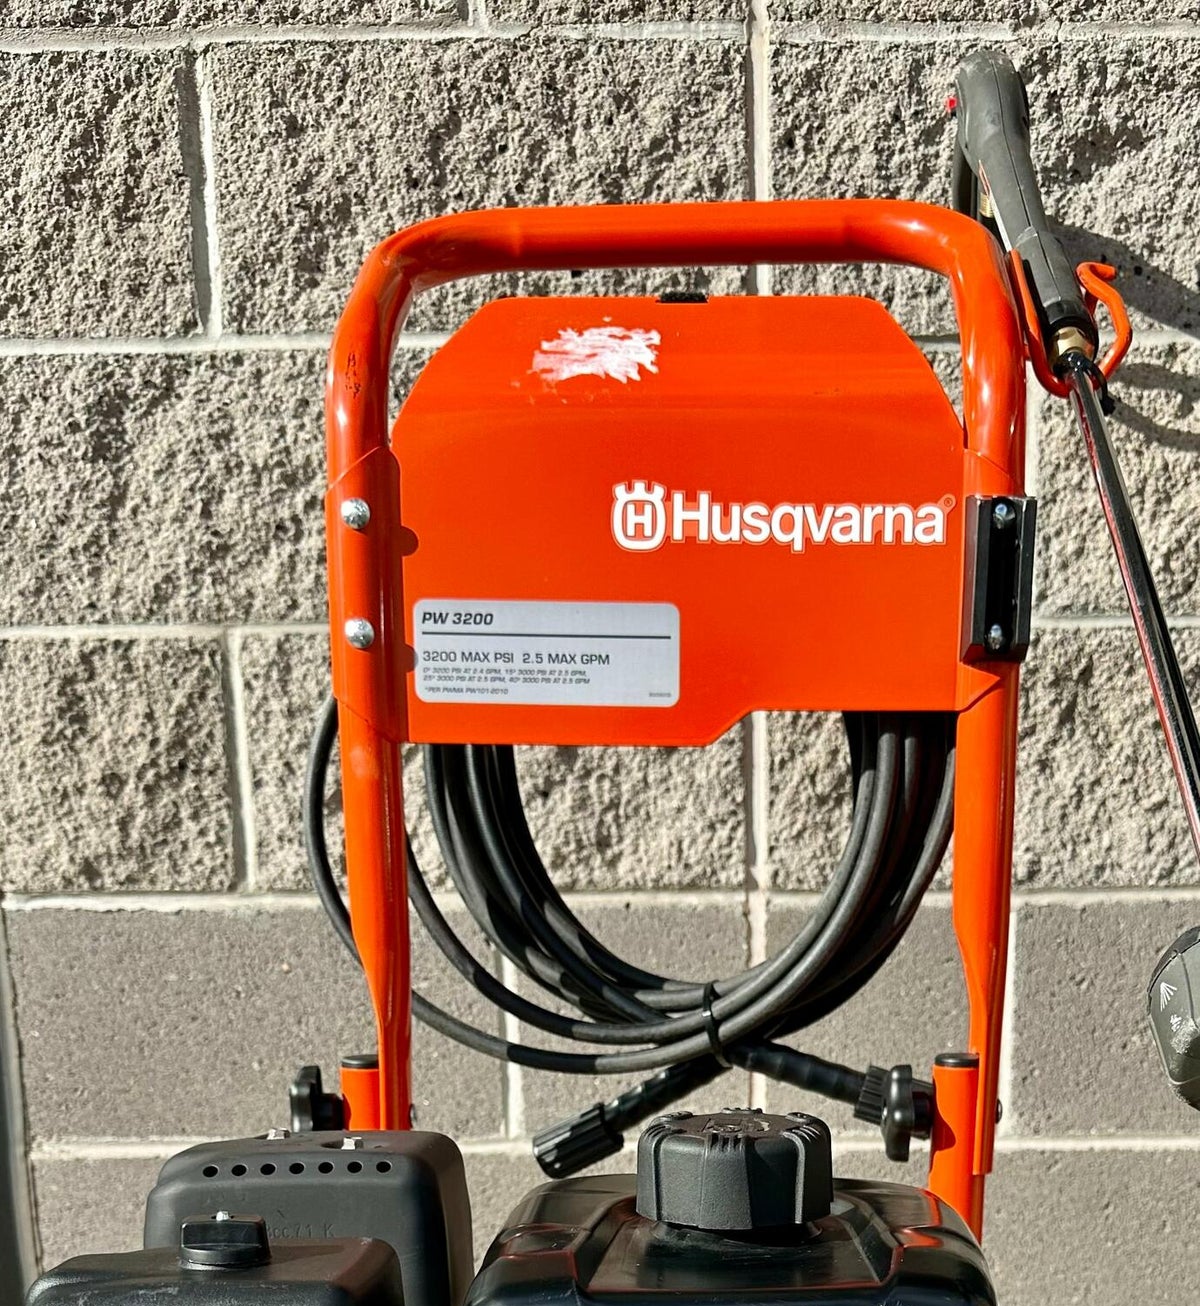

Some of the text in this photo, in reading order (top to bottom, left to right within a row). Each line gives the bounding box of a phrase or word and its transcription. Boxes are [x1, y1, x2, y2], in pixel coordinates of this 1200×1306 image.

[422, 612, 494, 625] PW 3200
[423, 651, 610, 665] 3200 MAX PSI 2.5 MAX GPM
